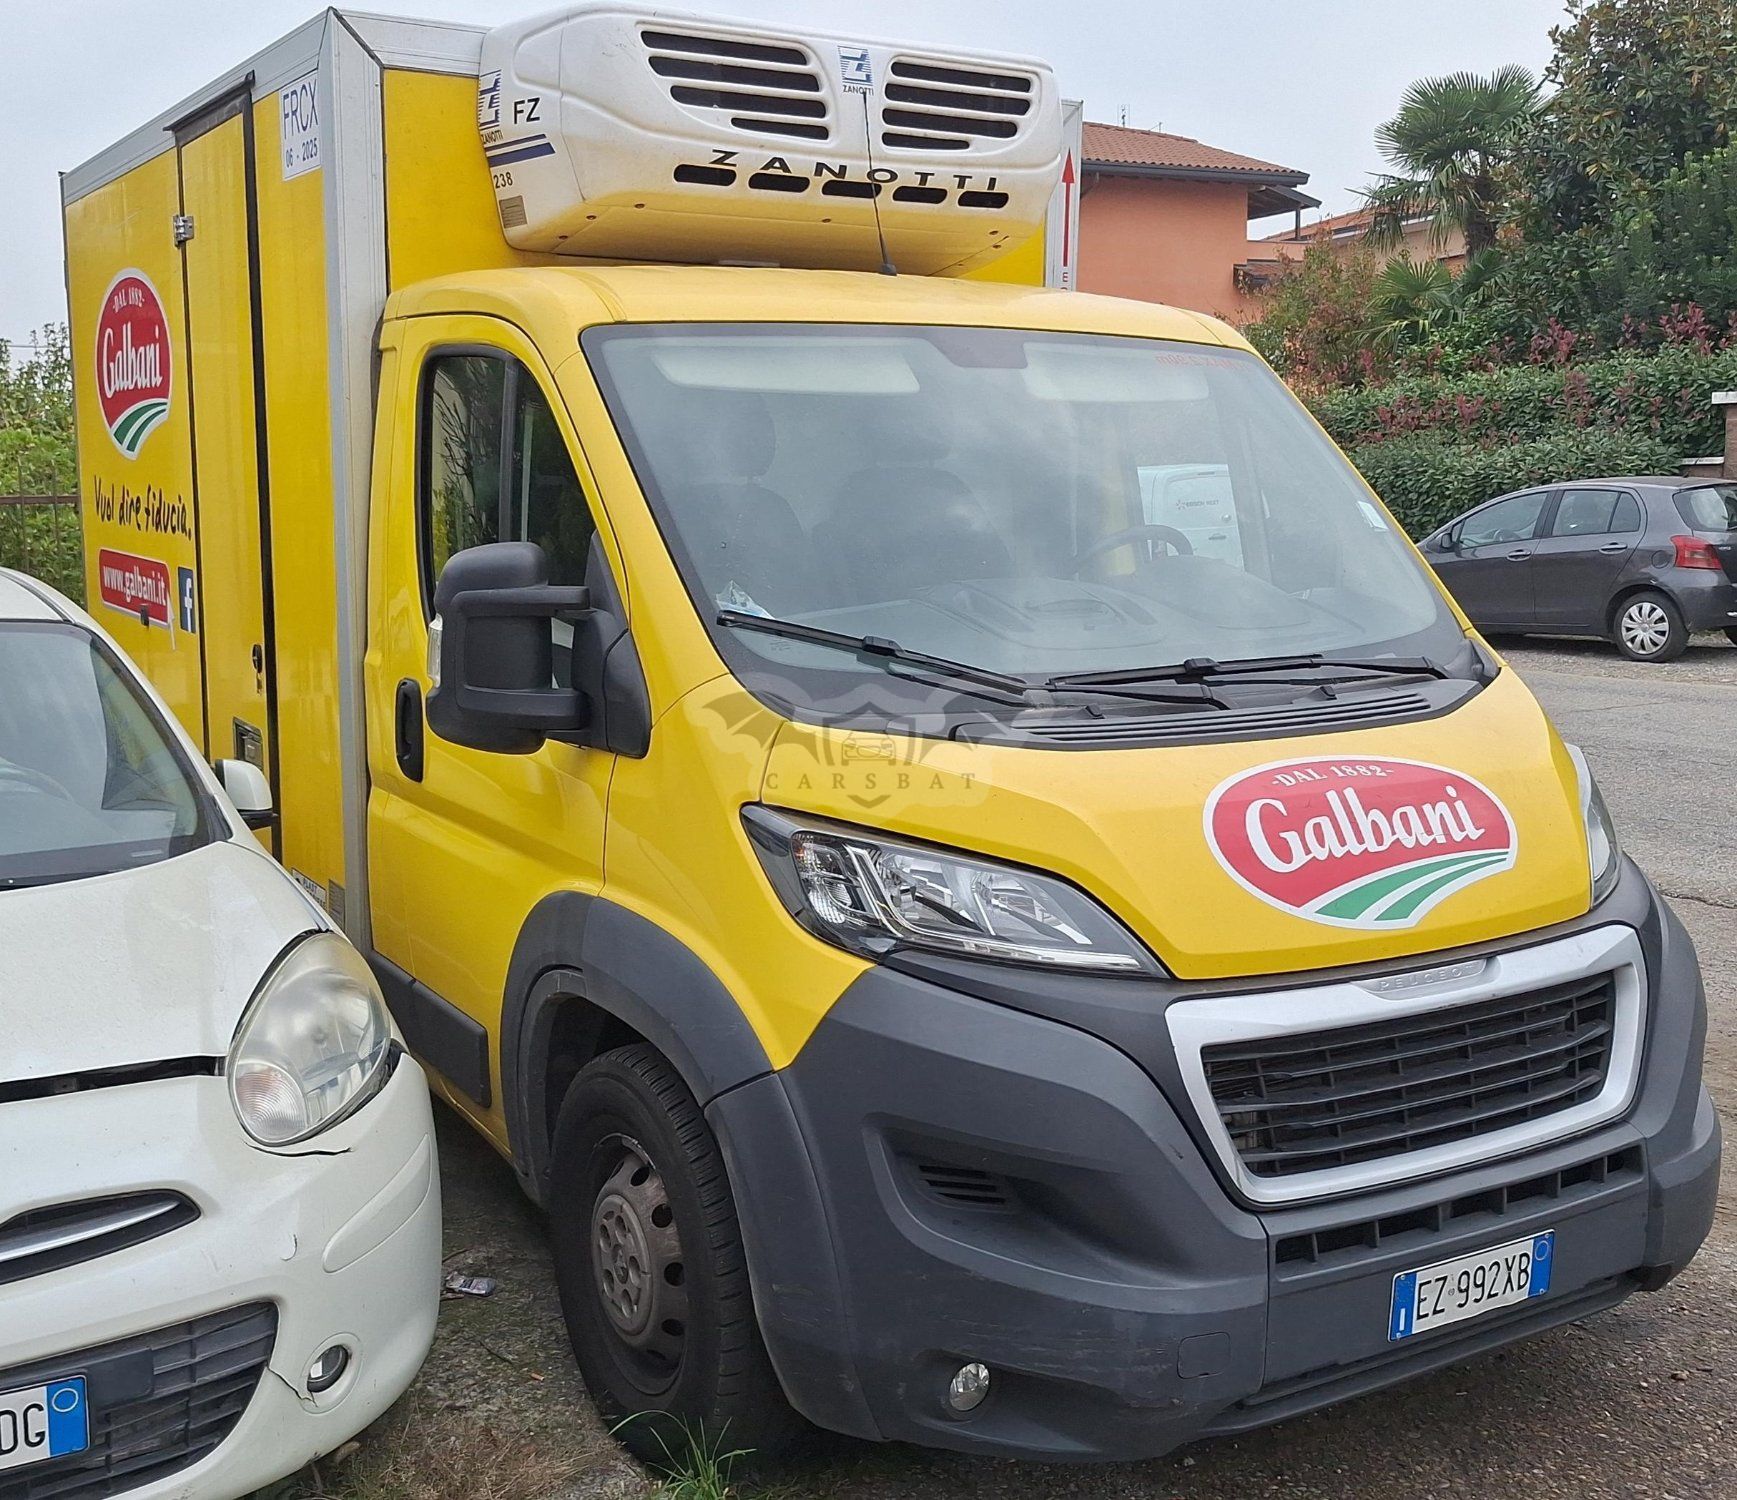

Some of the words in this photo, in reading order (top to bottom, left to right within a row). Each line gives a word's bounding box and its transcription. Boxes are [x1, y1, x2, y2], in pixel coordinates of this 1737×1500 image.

[283, 79, 319, 140] FRCX
[513, 97, 541, 125] FZ
[842, 84, 875, 97] ZANOTTI
[285, 147, 294, 169] 06
[302, 137, 318, 161] 2025
[481, 129, 503, 145] ZANOTTI
[493, 171, 513, 189] 238
[709, 149, 997, 191] ZANOTTI
[103, 321, 163, 399] Galbani
[93, 474, 115, 523] Vuol
[118, 484, 142, 532] dire
[143, 483, 193, 542] fiducia.
[103, 564, 167, 606] www.galbani.it
[1245, 785, 1486, 874] Galbani
